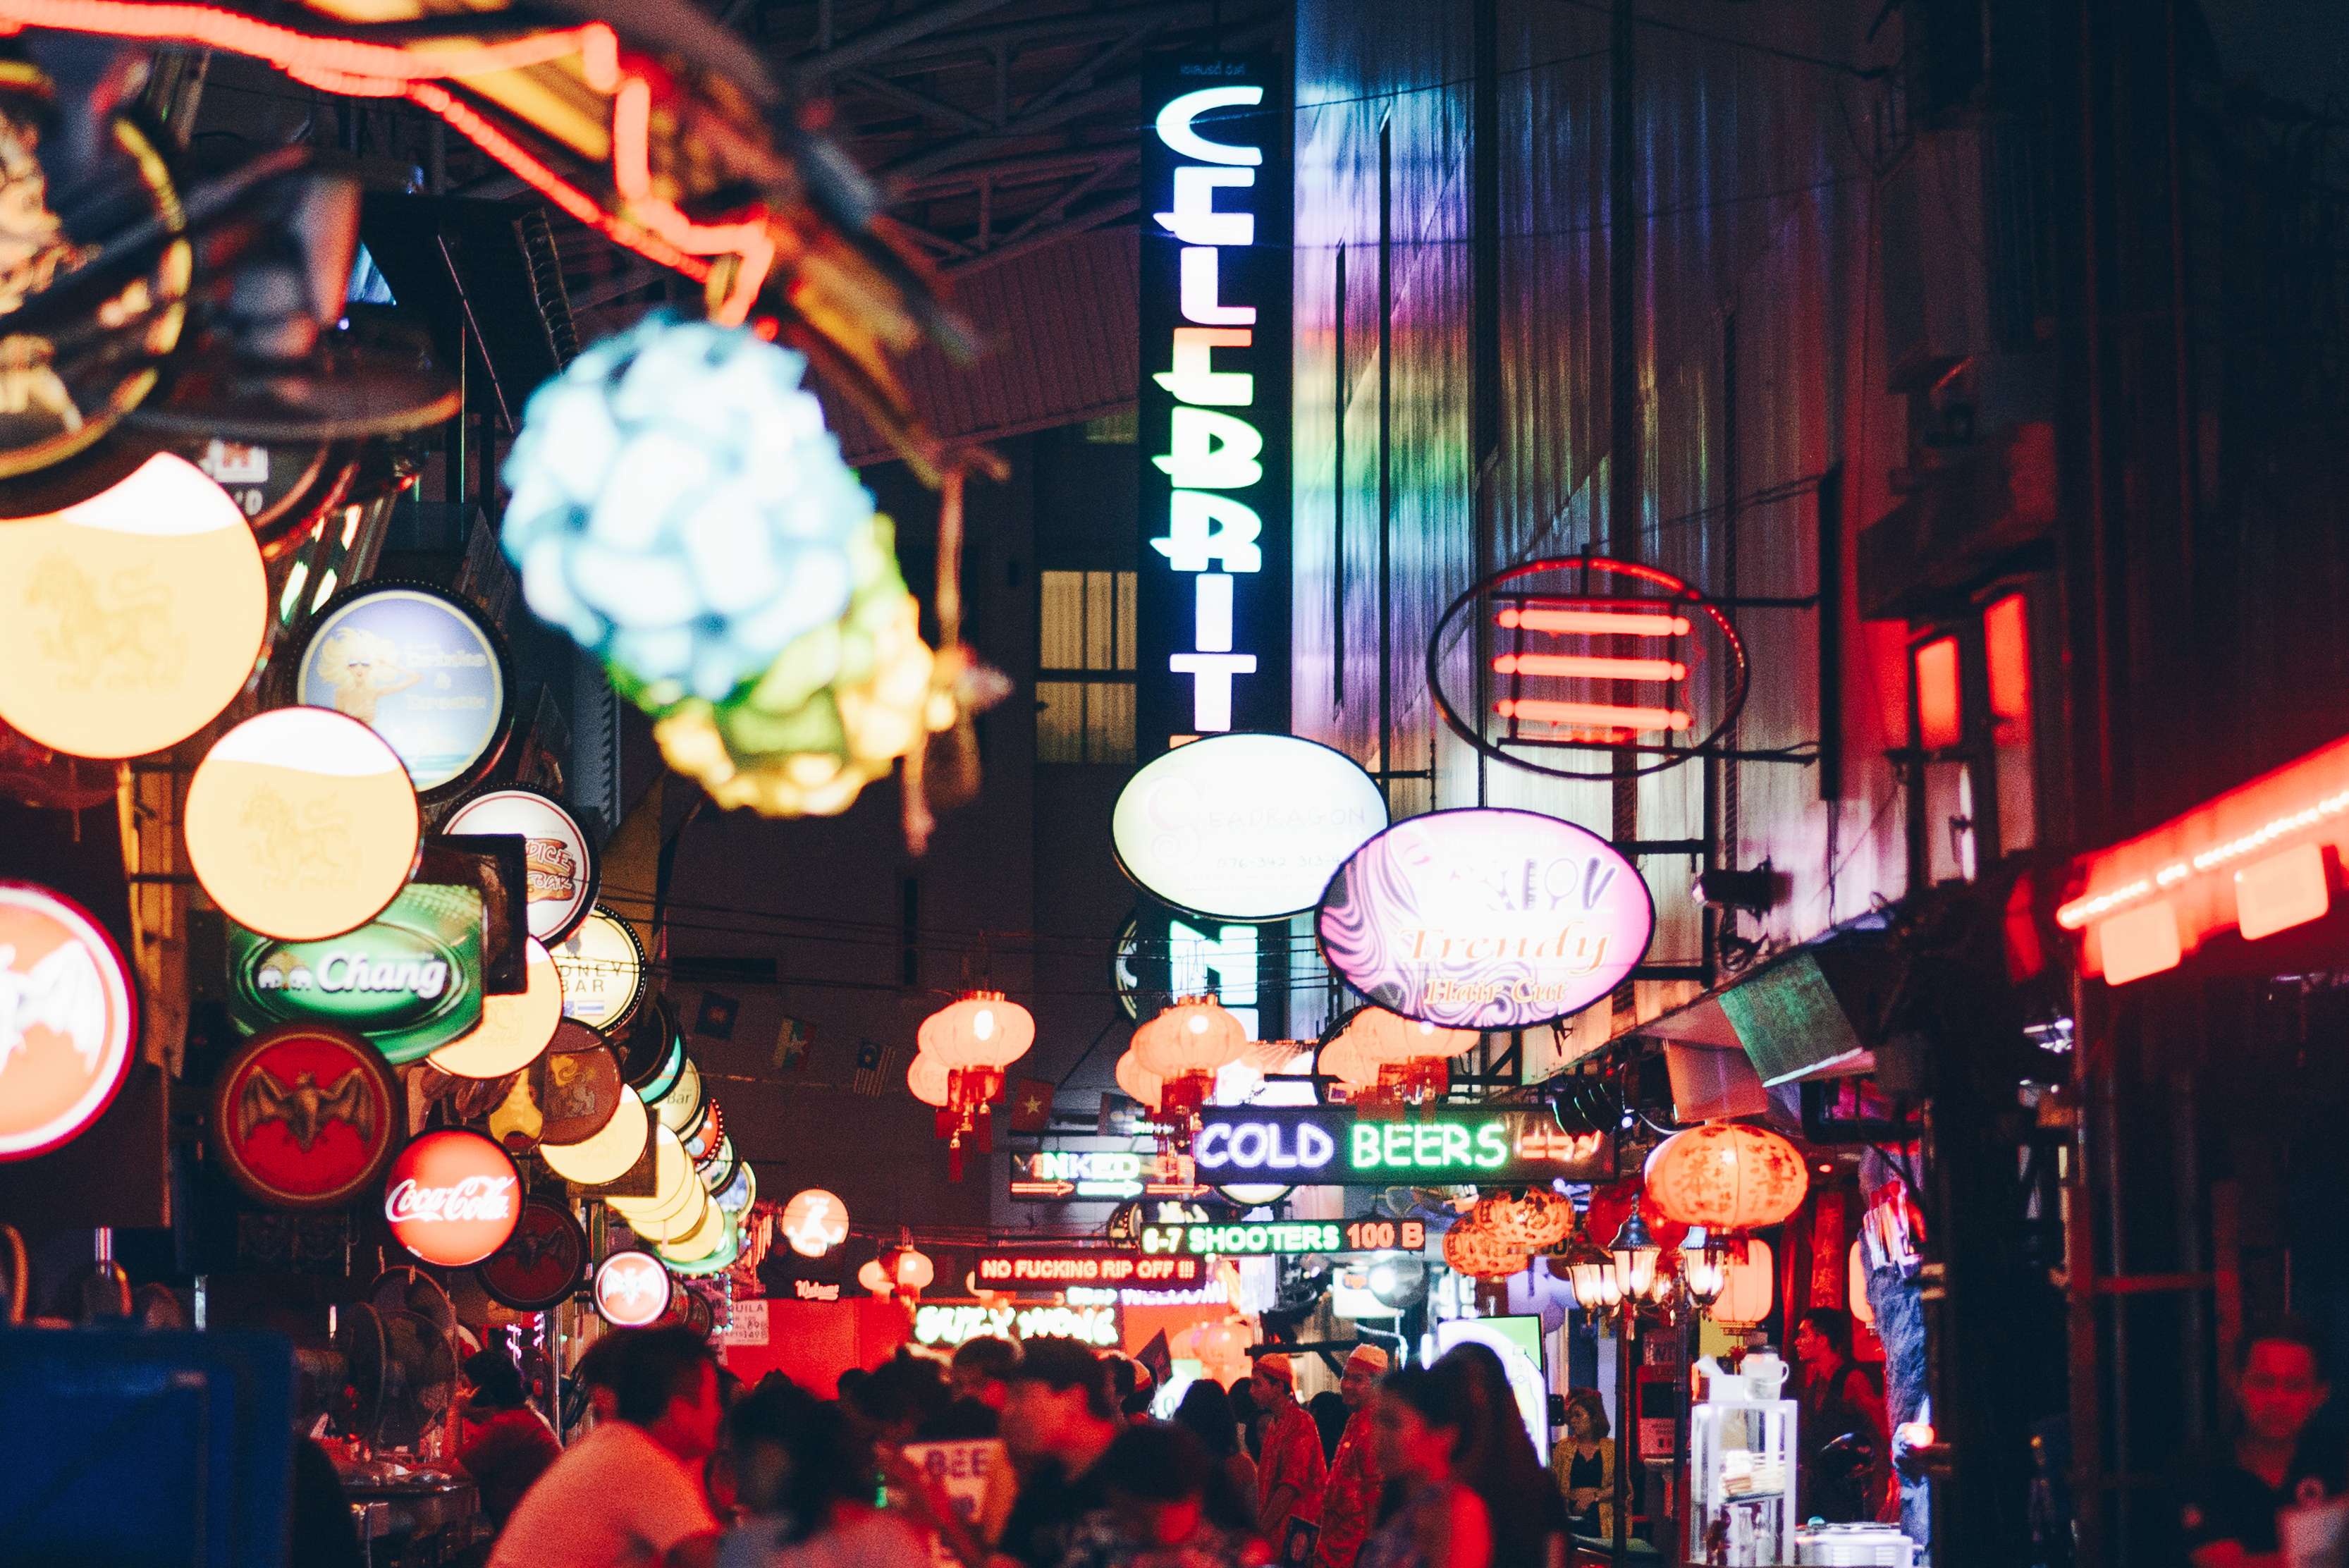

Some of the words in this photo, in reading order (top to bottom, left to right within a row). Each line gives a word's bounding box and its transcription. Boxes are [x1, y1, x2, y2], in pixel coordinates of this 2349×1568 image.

[1402, 921, 1612, 975] Trendy
[317, 951, 448, 999] Chang
[1423, 978, 1506, 1005] Hair
[1510, 977, 1568, 1005] Cut
[1198, 1122, 1334, 1169] COLD
[1352, 1122, 1507, 1169] BEERS
[385, 1176, 517, 1223] Coca-Cola
[1188, 1225, 1339, 1253] SHOOTERS
[1346, 1222, 1395, 1249] 100
[1402, 1222, 1424, 1249] B
[981, 1259, 1012, 1279] NO
[1014, 1259, 1098, 1279] FUCKING
[1100, 1259, 1134, 1279] RIP
[1136, 1259, 1174, 1279] OFF
[1178, 1259, 1196, 1279] !!!
[915, 1306, 1016, 1344] SUZY
